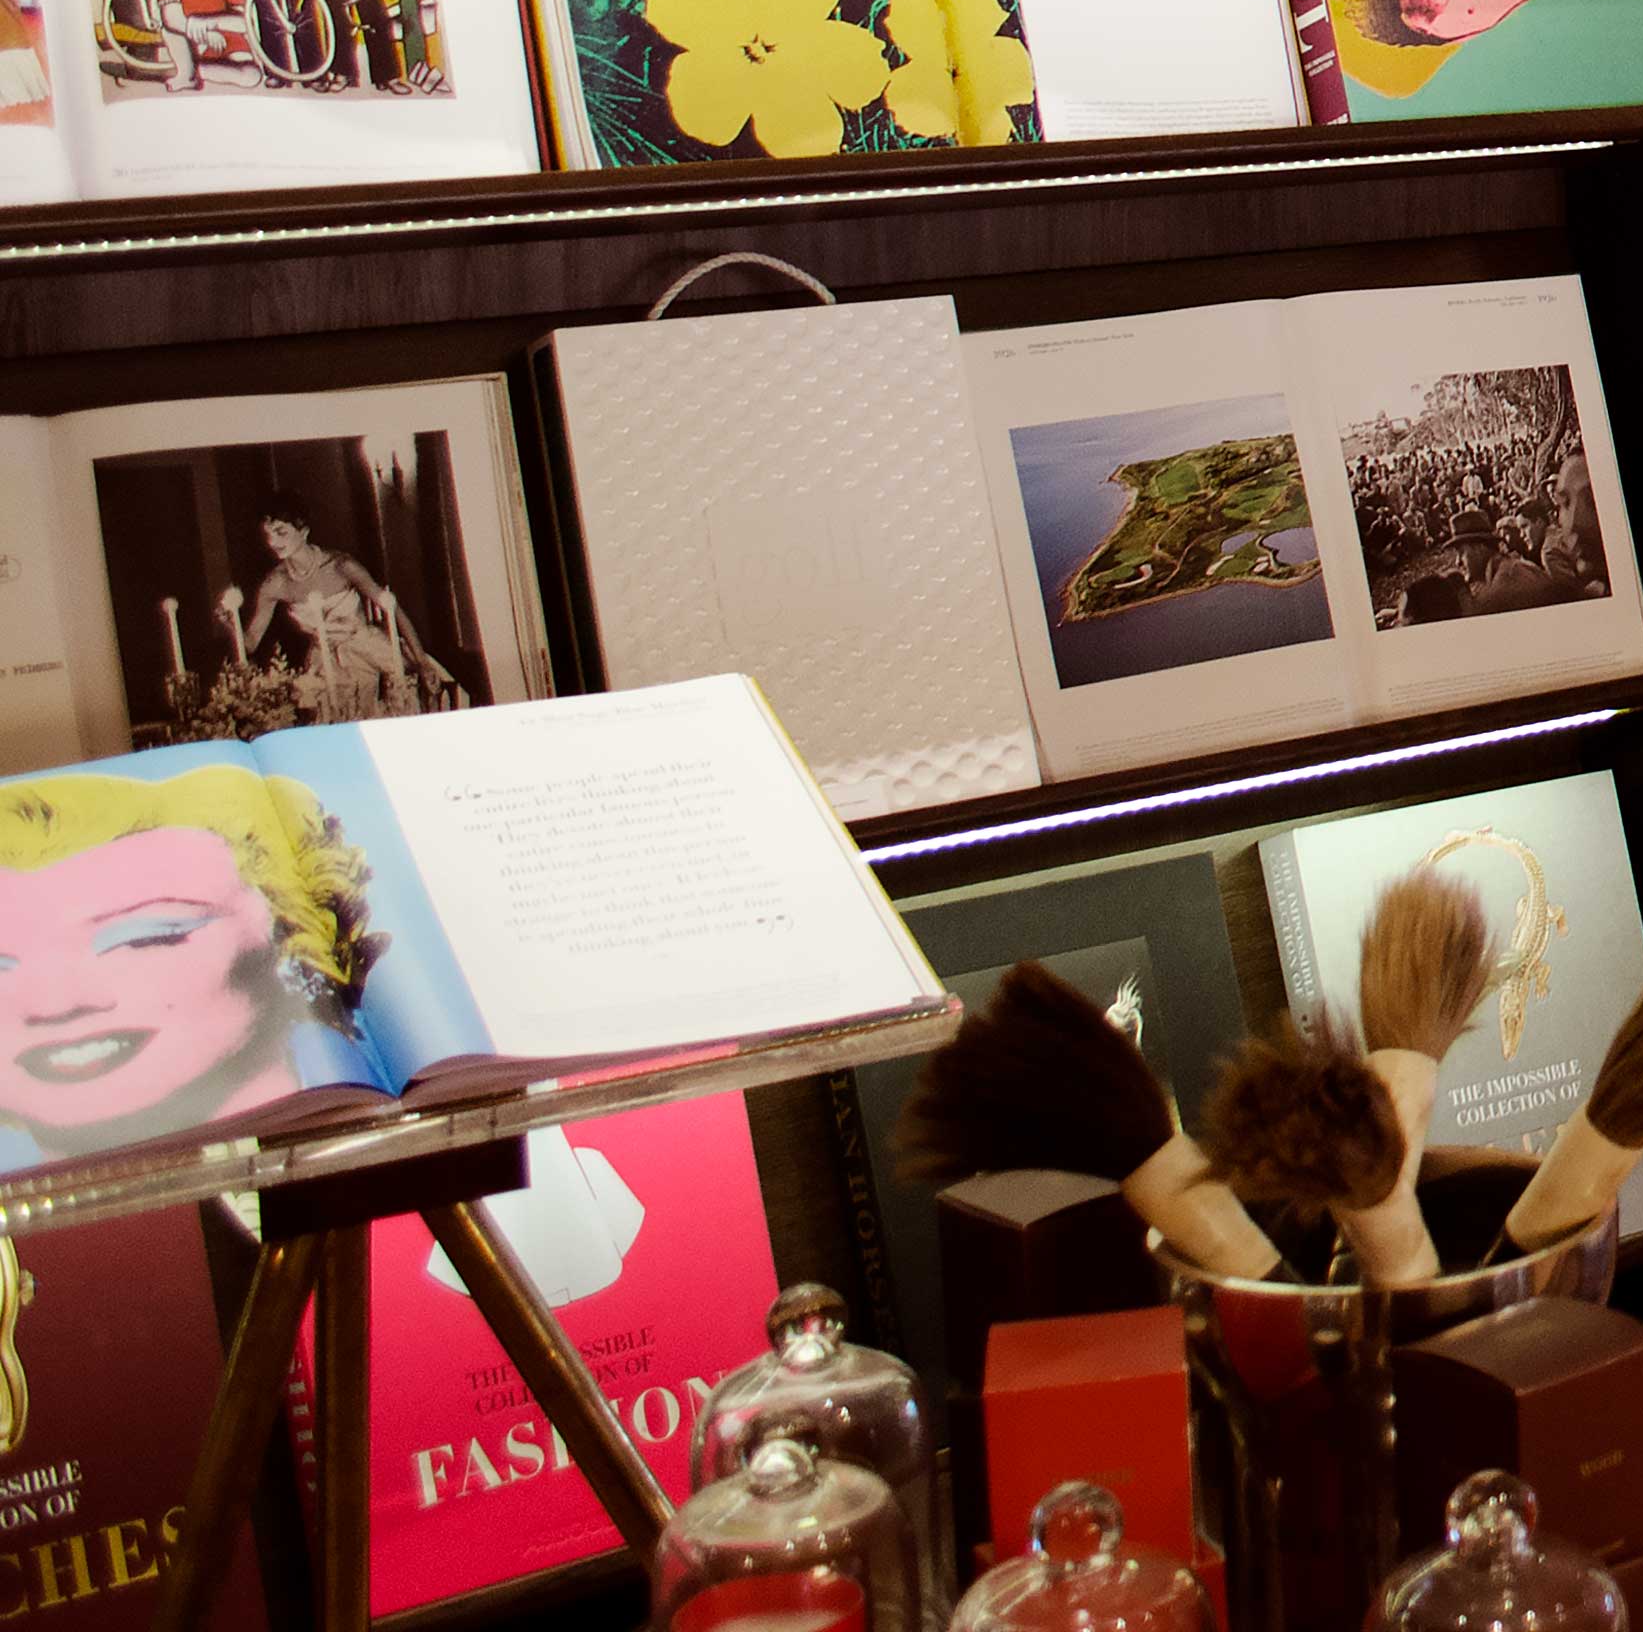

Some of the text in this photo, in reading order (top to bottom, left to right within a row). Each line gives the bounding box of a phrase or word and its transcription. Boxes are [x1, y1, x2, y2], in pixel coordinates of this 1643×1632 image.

[1447, 1058, 1582, 1107] THE IMPOSSIBLE
[1455, 1078, 1582, 1128] COLLECTION OF
[46, 1490, 82, 1524] OF
